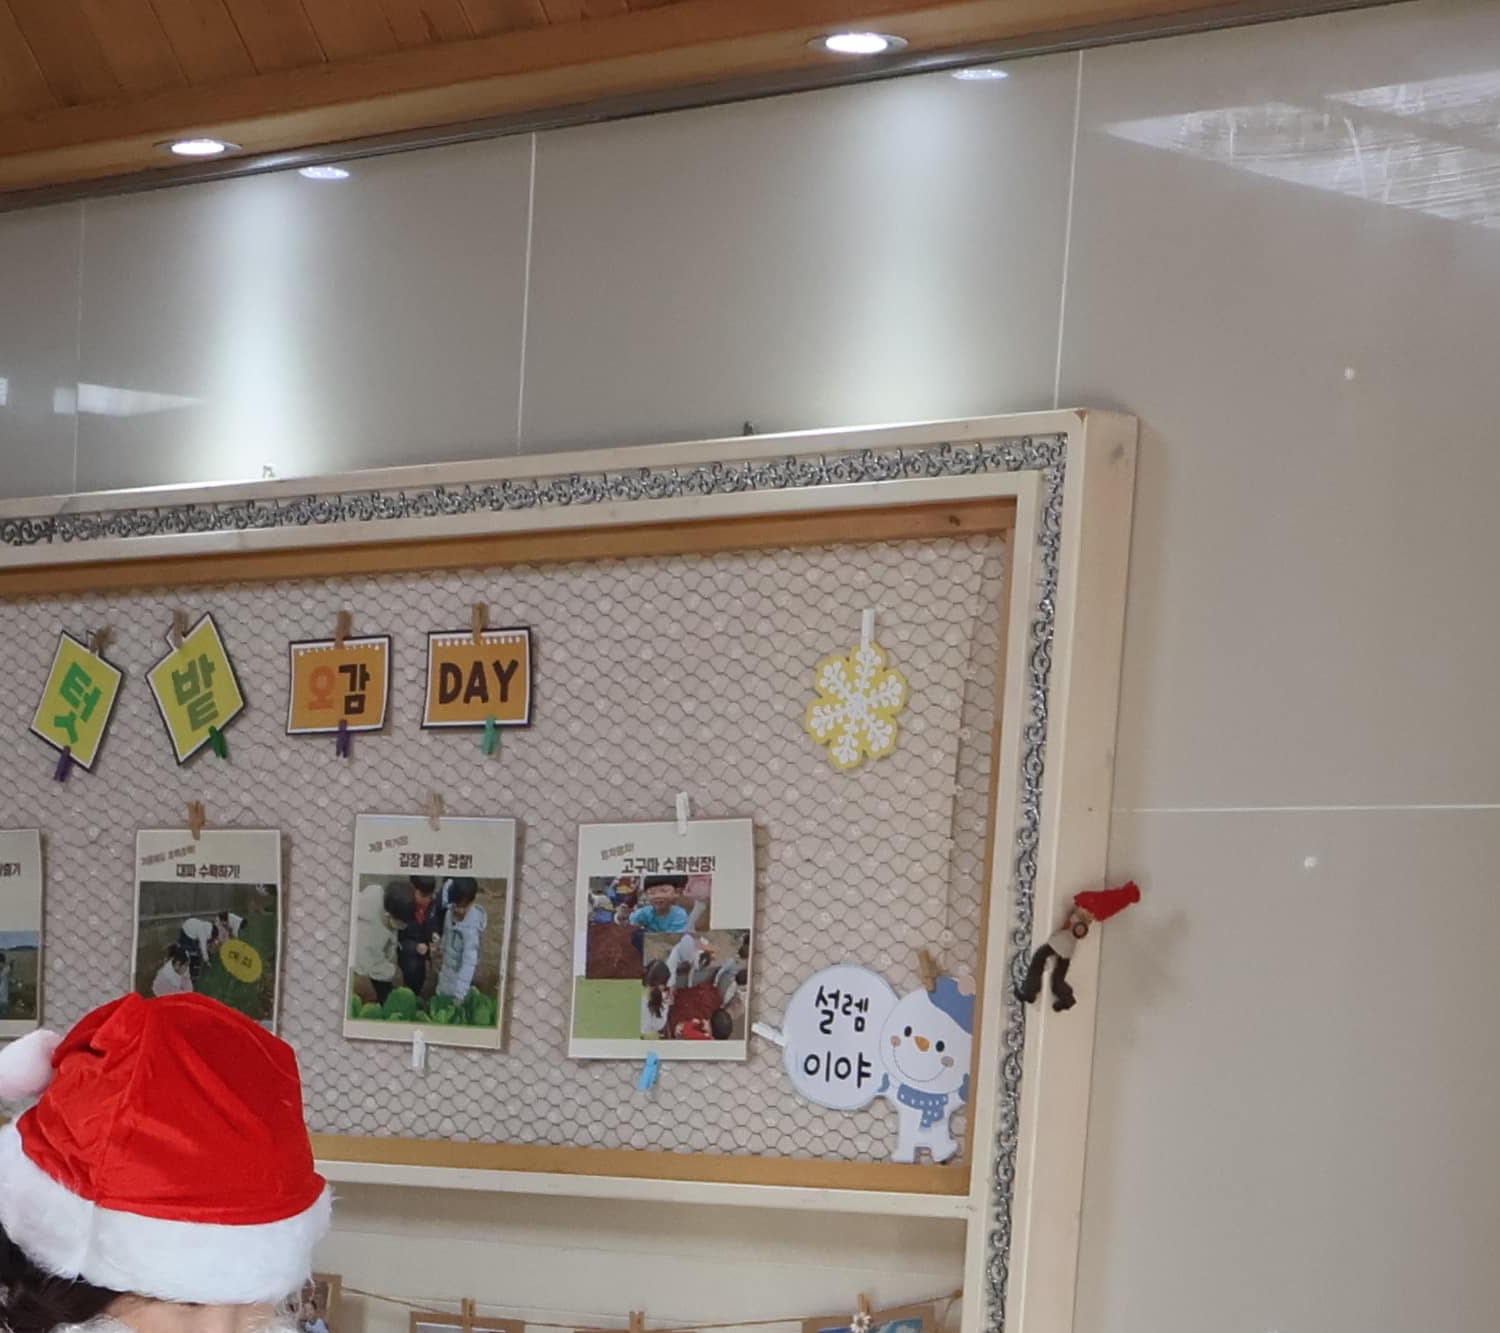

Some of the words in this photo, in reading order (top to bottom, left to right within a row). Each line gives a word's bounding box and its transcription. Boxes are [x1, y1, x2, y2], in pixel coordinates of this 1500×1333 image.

[54, 661, 103, 744] 텃
[171, 653, 220, 732] 밭
[308, 662, 371, 715] 오감
[438, 659, 519, 704] DAY
[621, 857, 660, 874] 고구마
[814, 984, 870, 1035] 설렘
[803, 1050, 873, 1089] 이야
